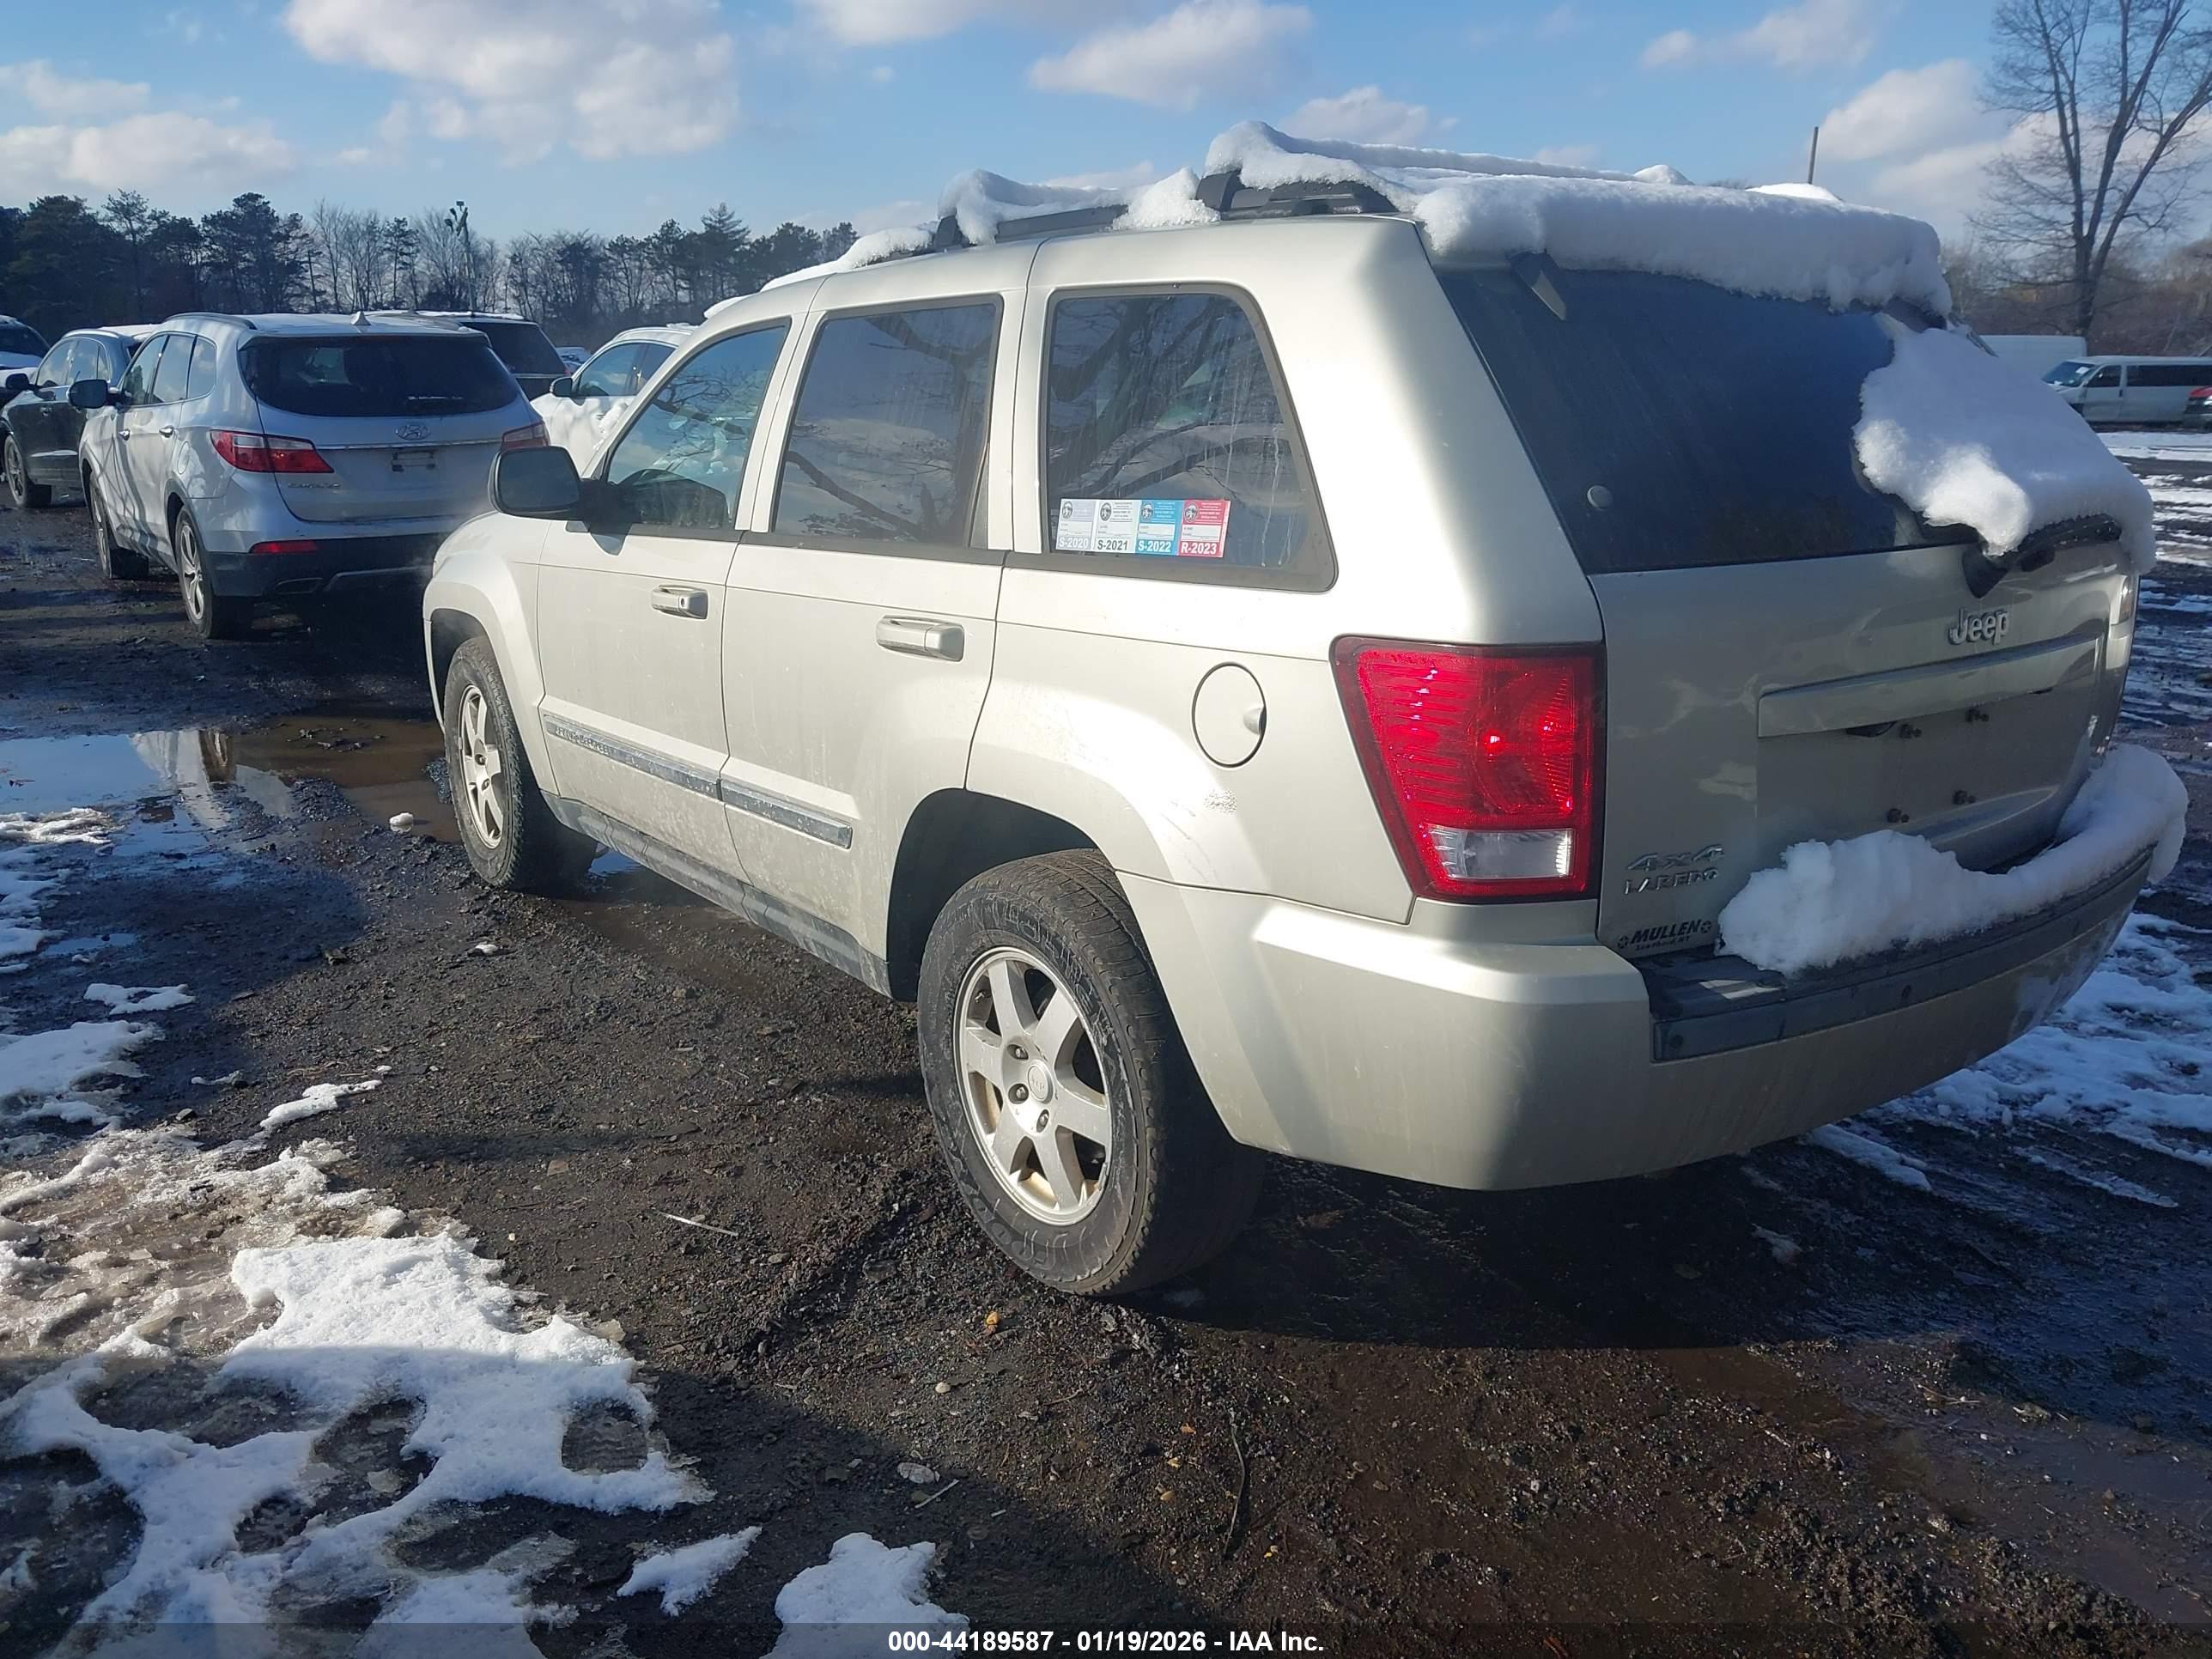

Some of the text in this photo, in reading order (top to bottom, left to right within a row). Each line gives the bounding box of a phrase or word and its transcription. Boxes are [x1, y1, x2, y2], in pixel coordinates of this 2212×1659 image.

[1059, 537, 1088, 549] S-2020
[1097, 539, 1128, 551] S-2021
[1138, 540, 1171, 553] S-2022
[1181, 541, 1217, 555] R-2023
[1948, 606, 2010, 646] Jeep
[1630, 919, 1702, 944] MULLEN
